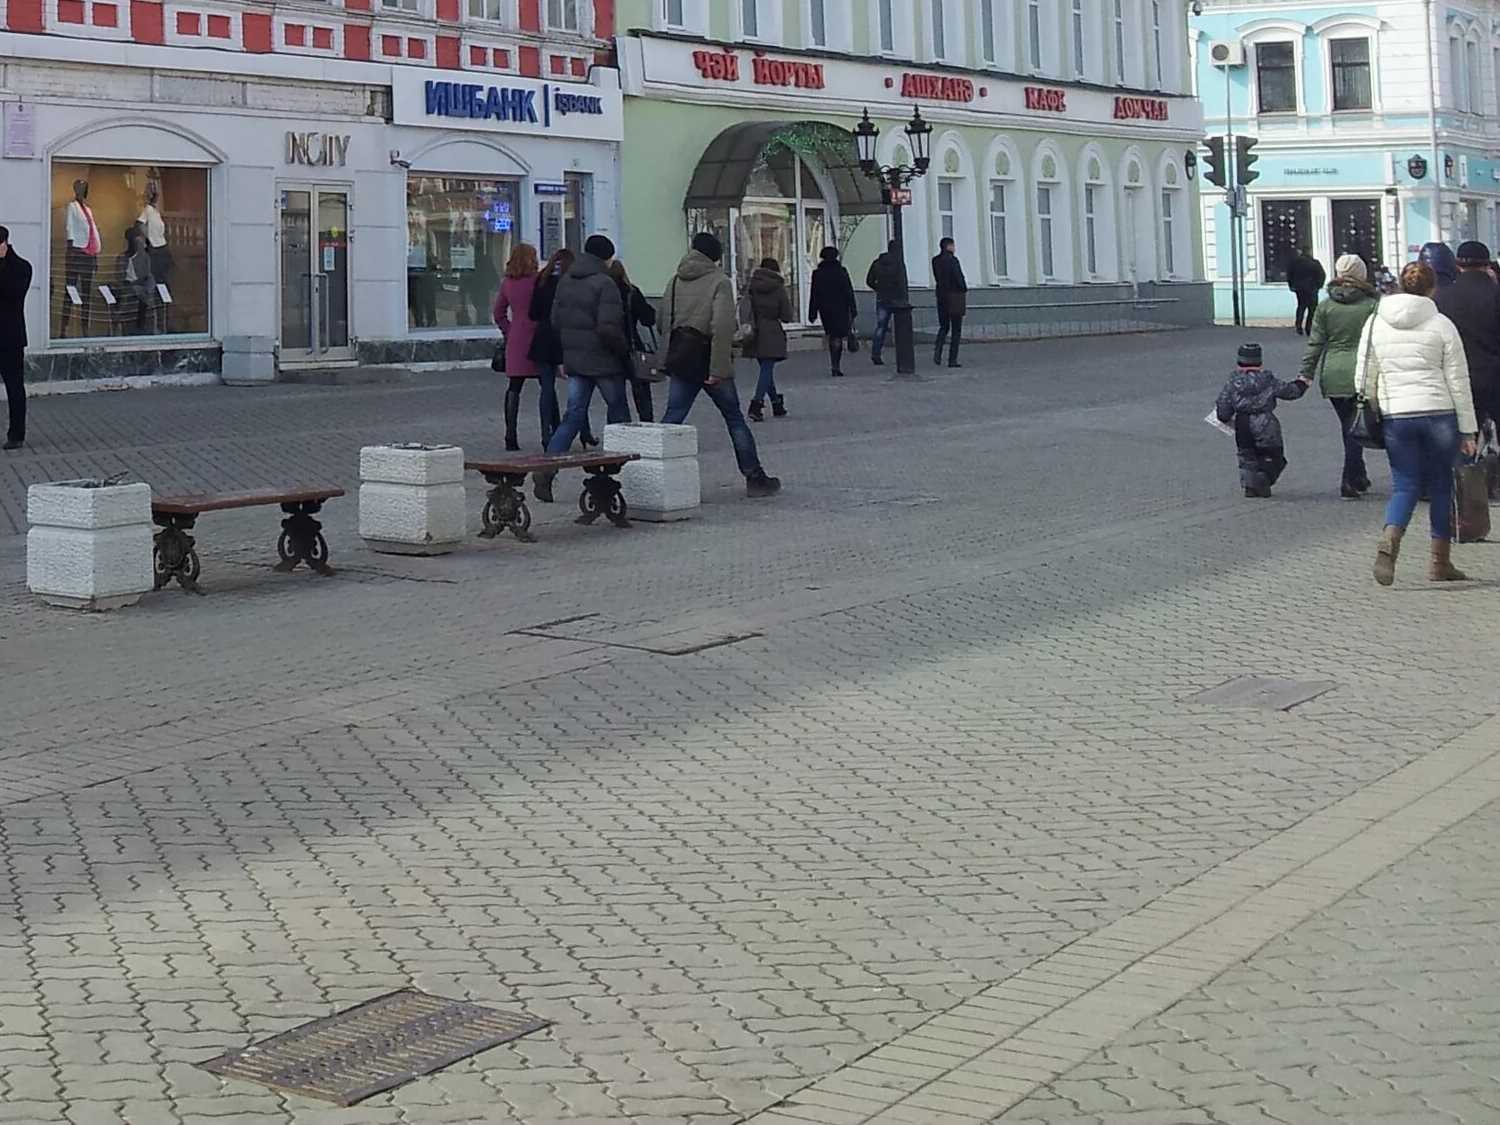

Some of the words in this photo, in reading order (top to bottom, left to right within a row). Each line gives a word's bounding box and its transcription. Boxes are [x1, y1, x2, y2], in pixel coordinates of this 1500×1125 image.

[692, 46, 740, 81] ЧӘЙ
[752, 50, 825, 89] ЙОРТЫ
[425, 80, 538, 124] ИШБАНК
[900, 73, 974, 103] АШХАНӘ
[1024, 86, 1066, 112] КАФЕ
[284, 131, 351, 167] INCITY
